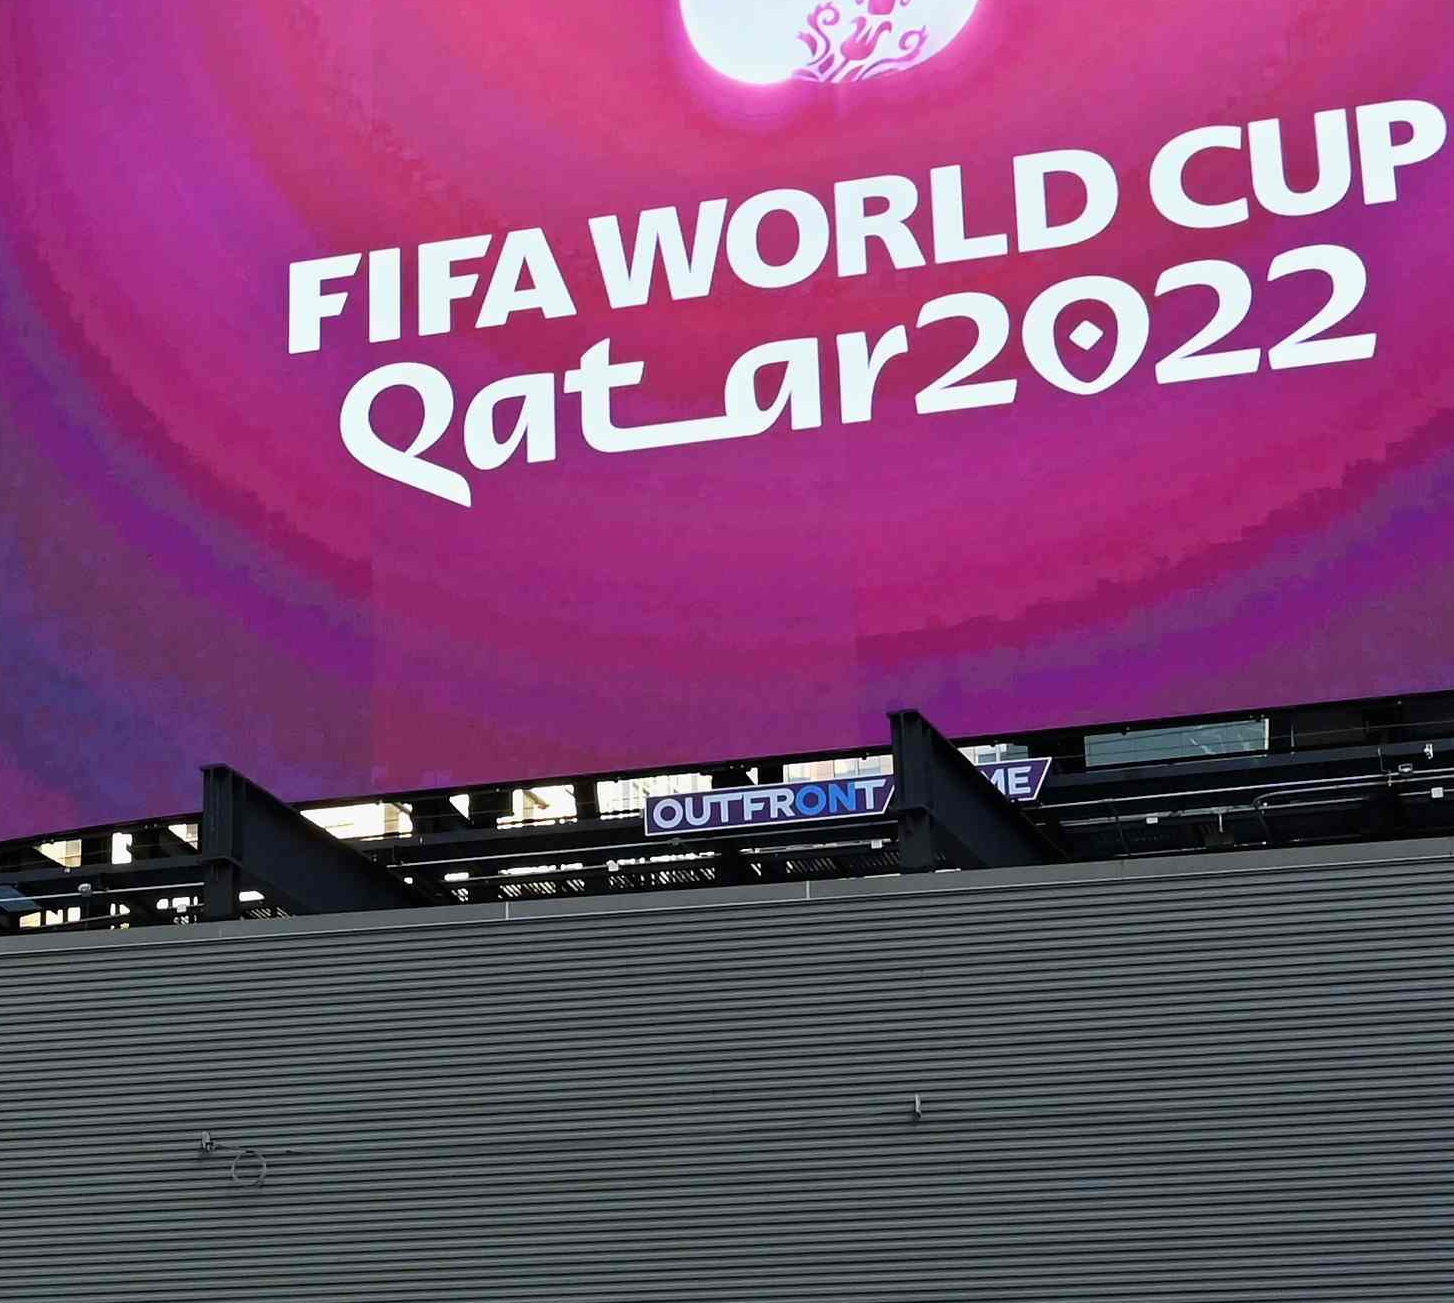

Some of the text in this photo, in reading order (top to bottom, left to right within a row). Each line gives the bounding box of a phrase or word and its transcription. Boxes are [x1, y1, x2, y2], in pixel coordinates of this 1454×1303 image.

[289, 99, 1447, 354] FIFA WORLD CUP
[652, 778, 888, 830] OUTFRONT
